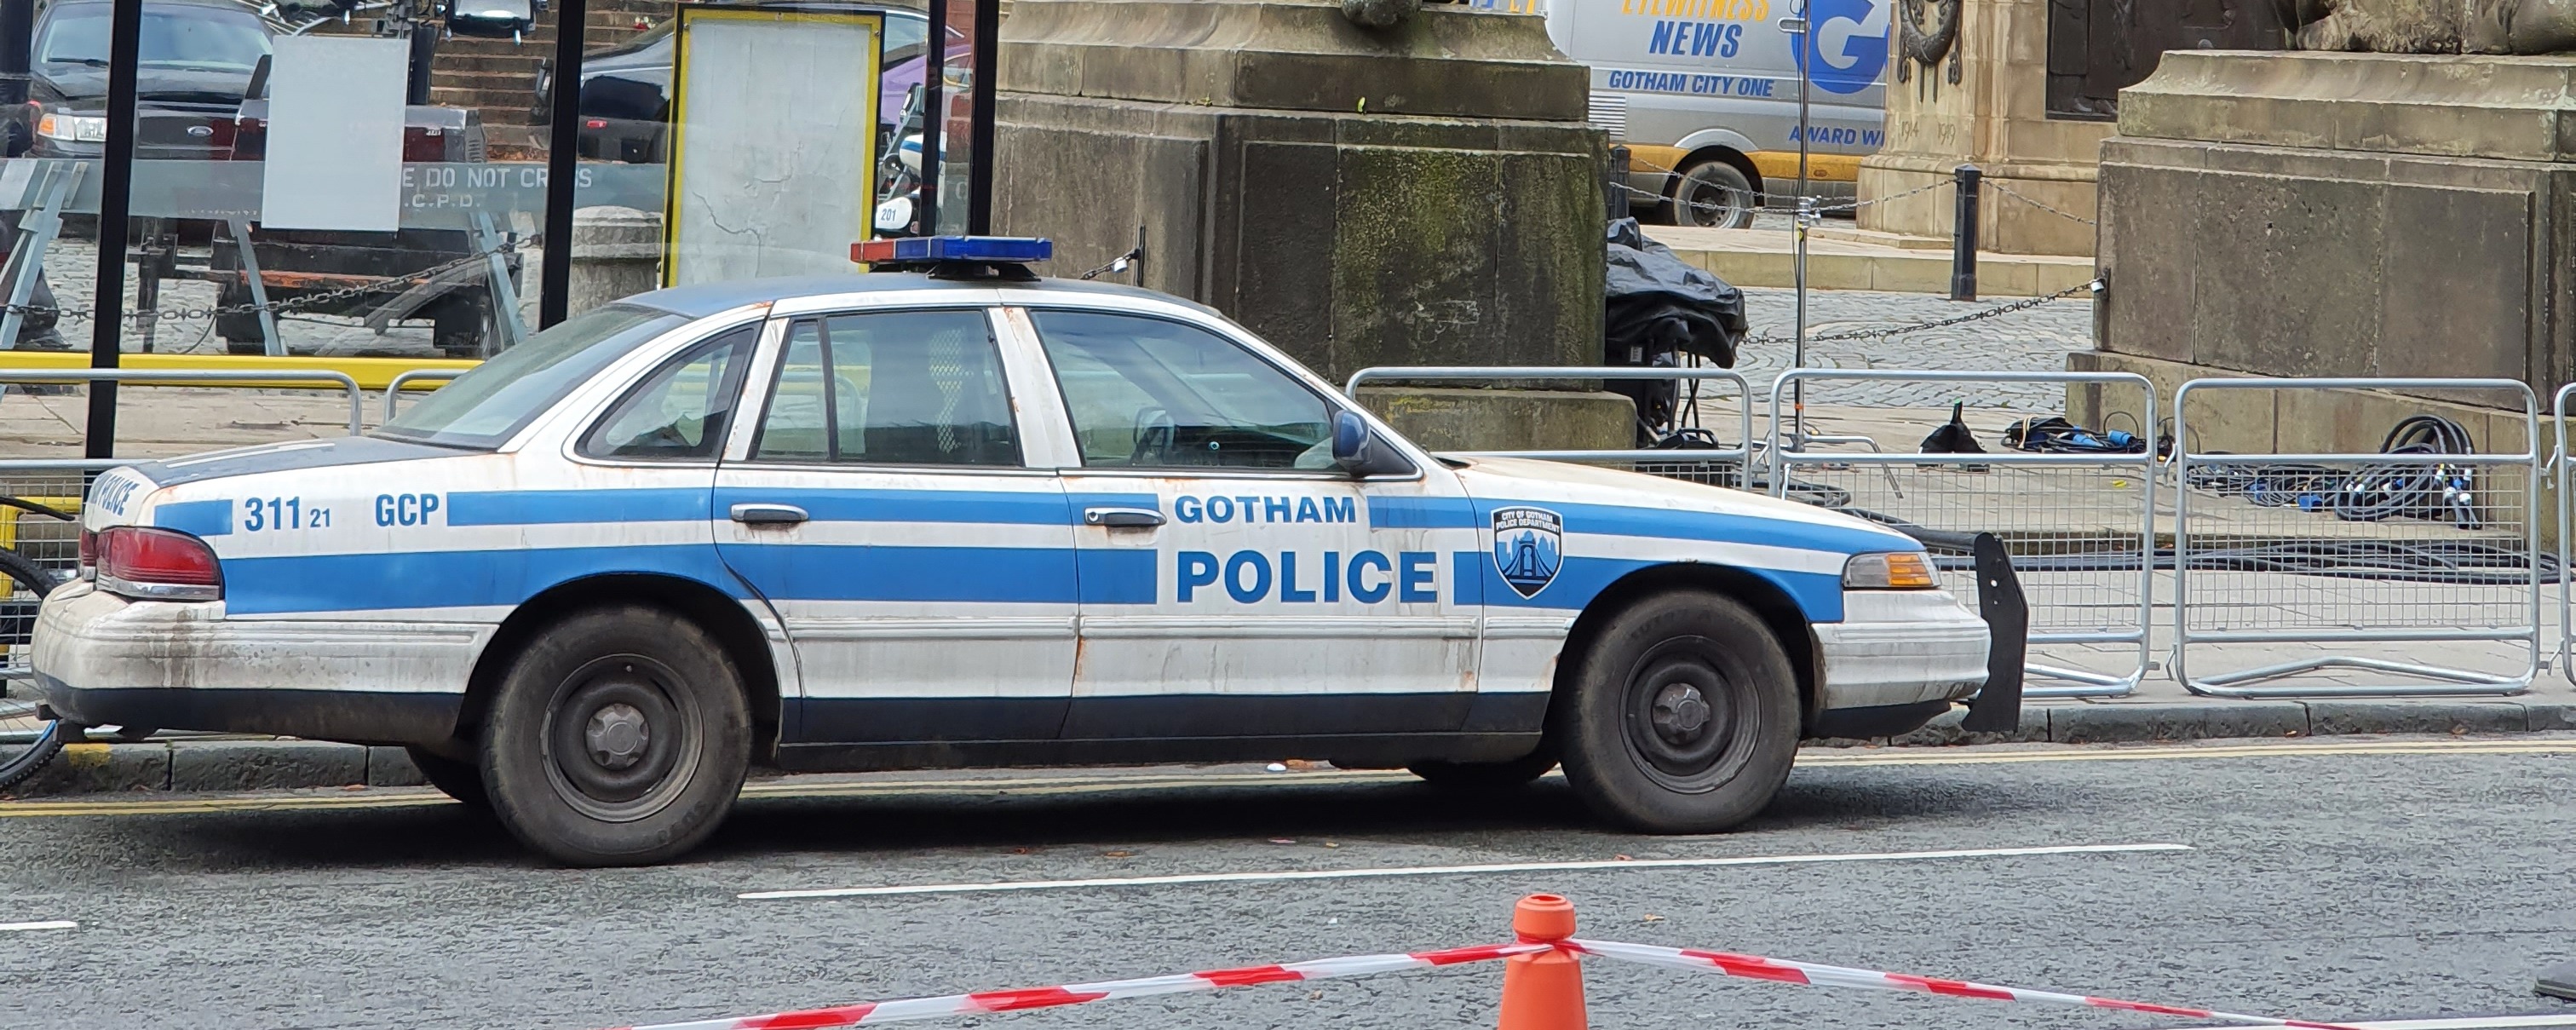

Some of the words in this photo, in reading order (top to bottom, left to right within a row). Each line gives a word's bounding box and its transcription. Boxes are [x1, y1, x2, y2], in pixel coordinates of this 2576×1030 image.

[1649, 20, 1743, 58] NEWS
[1609, 70, 1688, 92] GOTHAM
[1692, 75, 1734, 95] CITY
[1738, 78, 1774, 97] ONE
[426, 168, 456, 187] DO
[468, 168, 510, 188] NOT
[520, 169, 592, 188] CRS
[881, 209, 897, 222] 201
[100, 475, 140, 516] POLICE
[1175, 495, 1356, 523] GOTHAM
[244, 497, 300, 532] 311
[309, 509, 330, 527] 21
[375, 493, 440, 527] GCP
[1502, 511, 1515, 521] CITY
[1526, 511, 1553, 522] GOTHAM
[1496, 519, 1517, 530] POLICE
[1519, 519, 1560, 532] DEPARTMENT
[1177, 550, 1438, 604] POLICE
